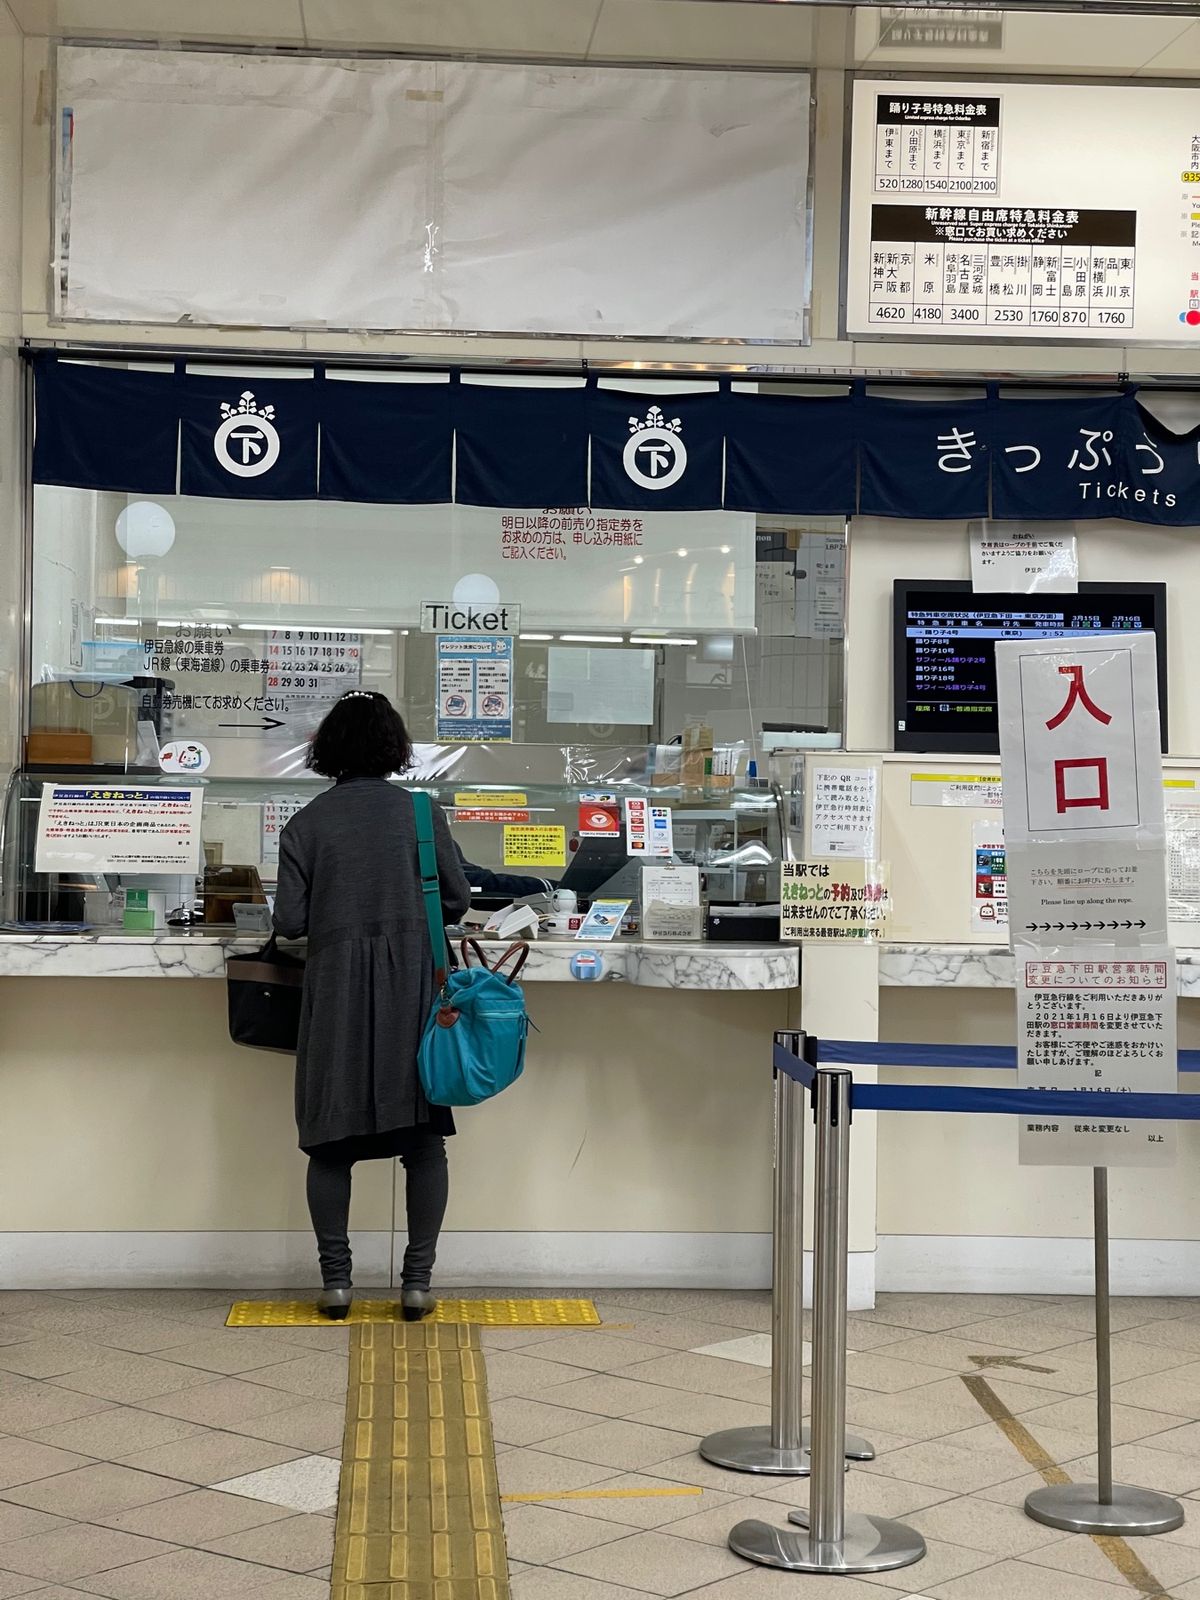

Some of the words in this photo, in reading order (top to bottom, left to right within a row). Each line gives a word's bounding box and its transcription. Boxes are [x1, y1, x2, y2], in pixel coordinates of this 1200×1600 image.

[889, 102, 987, 116] 踊り子号特急料金表
[885, 128, 894, 169] 伊東まで
[908, 128, 918, 170] 小田原まで
[932, 129, 942, 170] 横浜まで
[956, 130, 966, 171] 東京まで
[980, 130, 990, 172] 新宿まで
[880, 178, 898, 189] 520
[901, 179, 922, 190] 1280
[926, 180, 947, 190] 1540
[950, 180, 972, 190] 2100
[974, 181, 996, 190] 2100
[925, 206, 1079, 224] 新幹線自由席特急料金表
[874, 252, 884, 293] 新神戸
[886, 252, 898, 294] 新大阪
[900, 253, 911, 294] 京都
[923, 253, 935, 294] 米原
[946, 253, 956, 294] 岐阜羽島
[958, 254, 970, 294] 名古屋
[972, 254, 984, 294] 三河安城
[988, 255, 1000, 296] 豊橋
[1002, 256, 1014, 296] 浜松
[1016, 256, 1027, 296] 掛川
[1032, 256, 1044, 296] 静岡
[1046, 256, 1057, 297] 新富士
[1062, 257, 1073, 297] 三島
[1075, 257, 1087, 298] 小田原
[1092, 257, 1104, 298] 新横浜
[1106, 258, 1118, 298] 品川
[1119, 258, 1131, 298] 東京
[1062, 312, 1087, 323] 870
[230, 430, 264, 464] 下
[937, 427, 1200, 475] きっぷう
[638, 444, 672, 477] 下
[1078, 481, 1176, 507] Tickets
[502, 516, 643, 532] 明日以降の前売り指定券を
[502, 530, 643, 546] お求めの方は、申し込み用紙に
[502, 546, 567, 560] ご記入ください。
[426, 604, 508, 631] Ticket
[272, 630, 278, 639] 7
[284, 630, 291, 640] 8
[298, 631, 304, 640] 9
[310, 632, 320, 640] 10
[324, 632, 332, 640] 11
[336, 633, 346, 641] 12
[144, 640, 224, 655] 伊豆急線の乗車券
[269, 646, 279, 655] 14
[282, 646, 292, 656] 15
[296, 646, 306, 656] 16
[308, 647, 318, 656] 17
[322, 648, 332, 656] 18
[336, 648, 345, 656] 19
[269, 662, 278, 670] 21
[281, 662, 292, 672] 22
[295, 662, 306, 672] 23
[308, 663, 318, 672] 24
[321, 664, 332, 672] 25
[334, 664, 345, 672] 26
[268, 677, 278, 686] 28
[281, 678, 292, 686] 29
[294, 678, 305, 688] 30
[308, 678, 318, 688] 31
[142, 694, 290, 712] 自券売機にてお求めください。
[1046, 665, 1112, 814] 入口
[840, 774, 850, 782] QR
[266, 824, 276, 832] 25
[784, 864, 830, 877] 当駅では
[1086, 898, 1104, 906] along
[1028, 964, 1164, 974] 伊豆急下田駅営業時間
[1028, 975, 1164, 985] 変更についてのお知らせ
[1027, 1002, 1086, 1010] とうございます。
[1026, 1022, 1162, 1030] 田駅の窓口営業時間を変更させていた
[1026, 1030, 1062, 1038] だきます。
[1026, 1050, 1163, 1058] たしますが、ご理解のほどよろしくお
[1035, 1041, 1163, 1049] お客様にご不便やご迷惑をおかけい
[1026, 1058, 1094, 1066] 願い申しあげます。
[1027, 1124, 1059, 1132] 業務内容
[1074, 1124, 1130, 1132] 従来と変更なし
